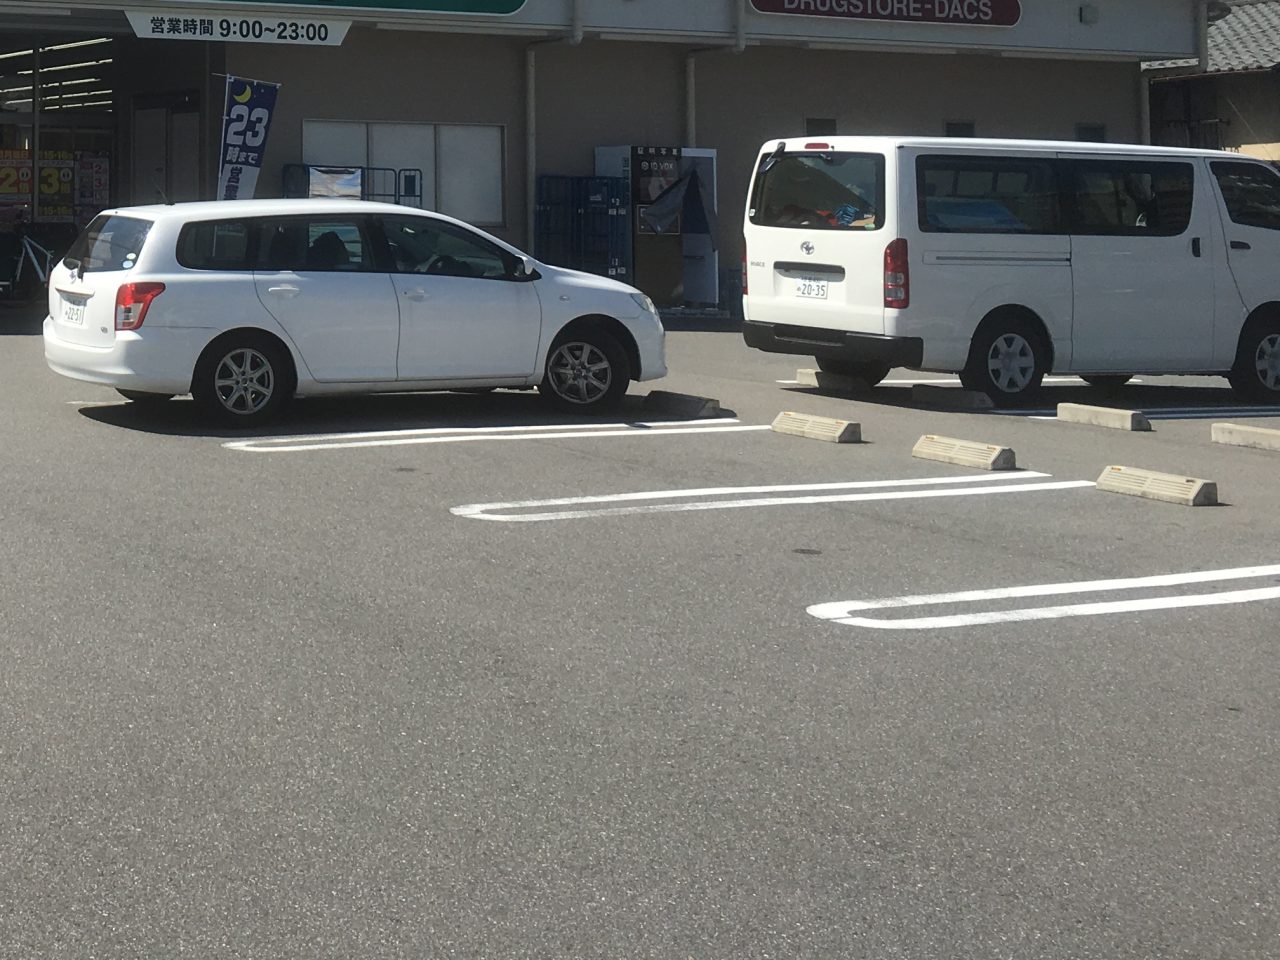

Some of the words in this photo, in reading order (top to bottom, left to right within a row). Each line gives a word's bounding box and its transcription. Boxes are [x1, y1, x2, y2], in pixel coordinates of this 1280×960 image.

[150, 17, 214, 36] 営業時間
[226, 105, 269, 147] 23
